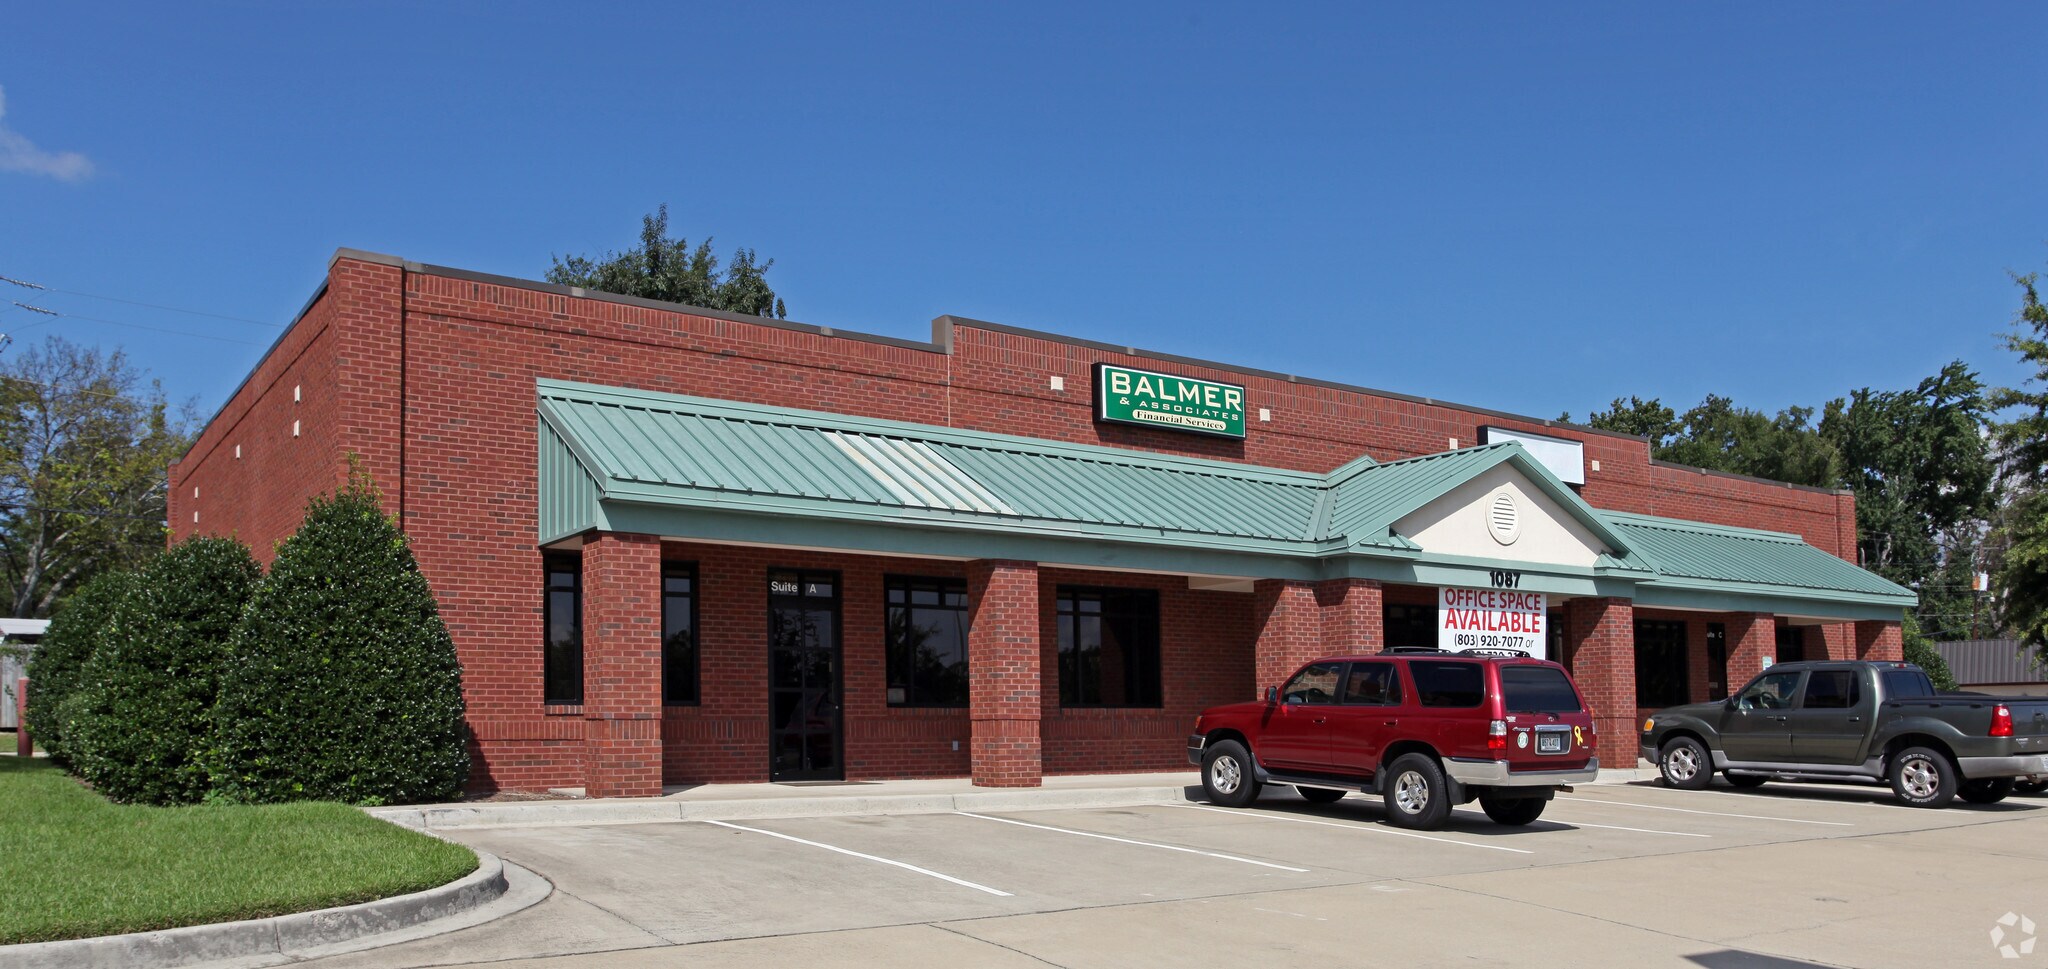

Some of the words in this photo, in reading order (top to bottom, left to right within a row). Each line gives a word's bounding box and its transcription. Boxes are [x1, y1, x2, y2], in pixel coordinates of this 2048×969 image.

[1111, 371, 1242, 412] BALMER
[1119, 397, 1130, 405] &
[1139, 400, 1239, 421] ASSOCIATES
[1136, 410, 1183, 424] Financial
[1185, 415, 1224, 430] Services
[771, 581, 798, 592] Suite
[809, 583, 817, 593] A
[1489, 570, 1521, 588] 1087
[1445, 588, 1496, 608] OFFICE
[1499, 591, 1541, 611] SPACE
[1444, 607, 1541, 633] AVAILABLE
[1454, 633, 1478, 648] (803)
[1481, 635, 1524, 648] 920-7077
[1525, 639, 1534, 648] or
